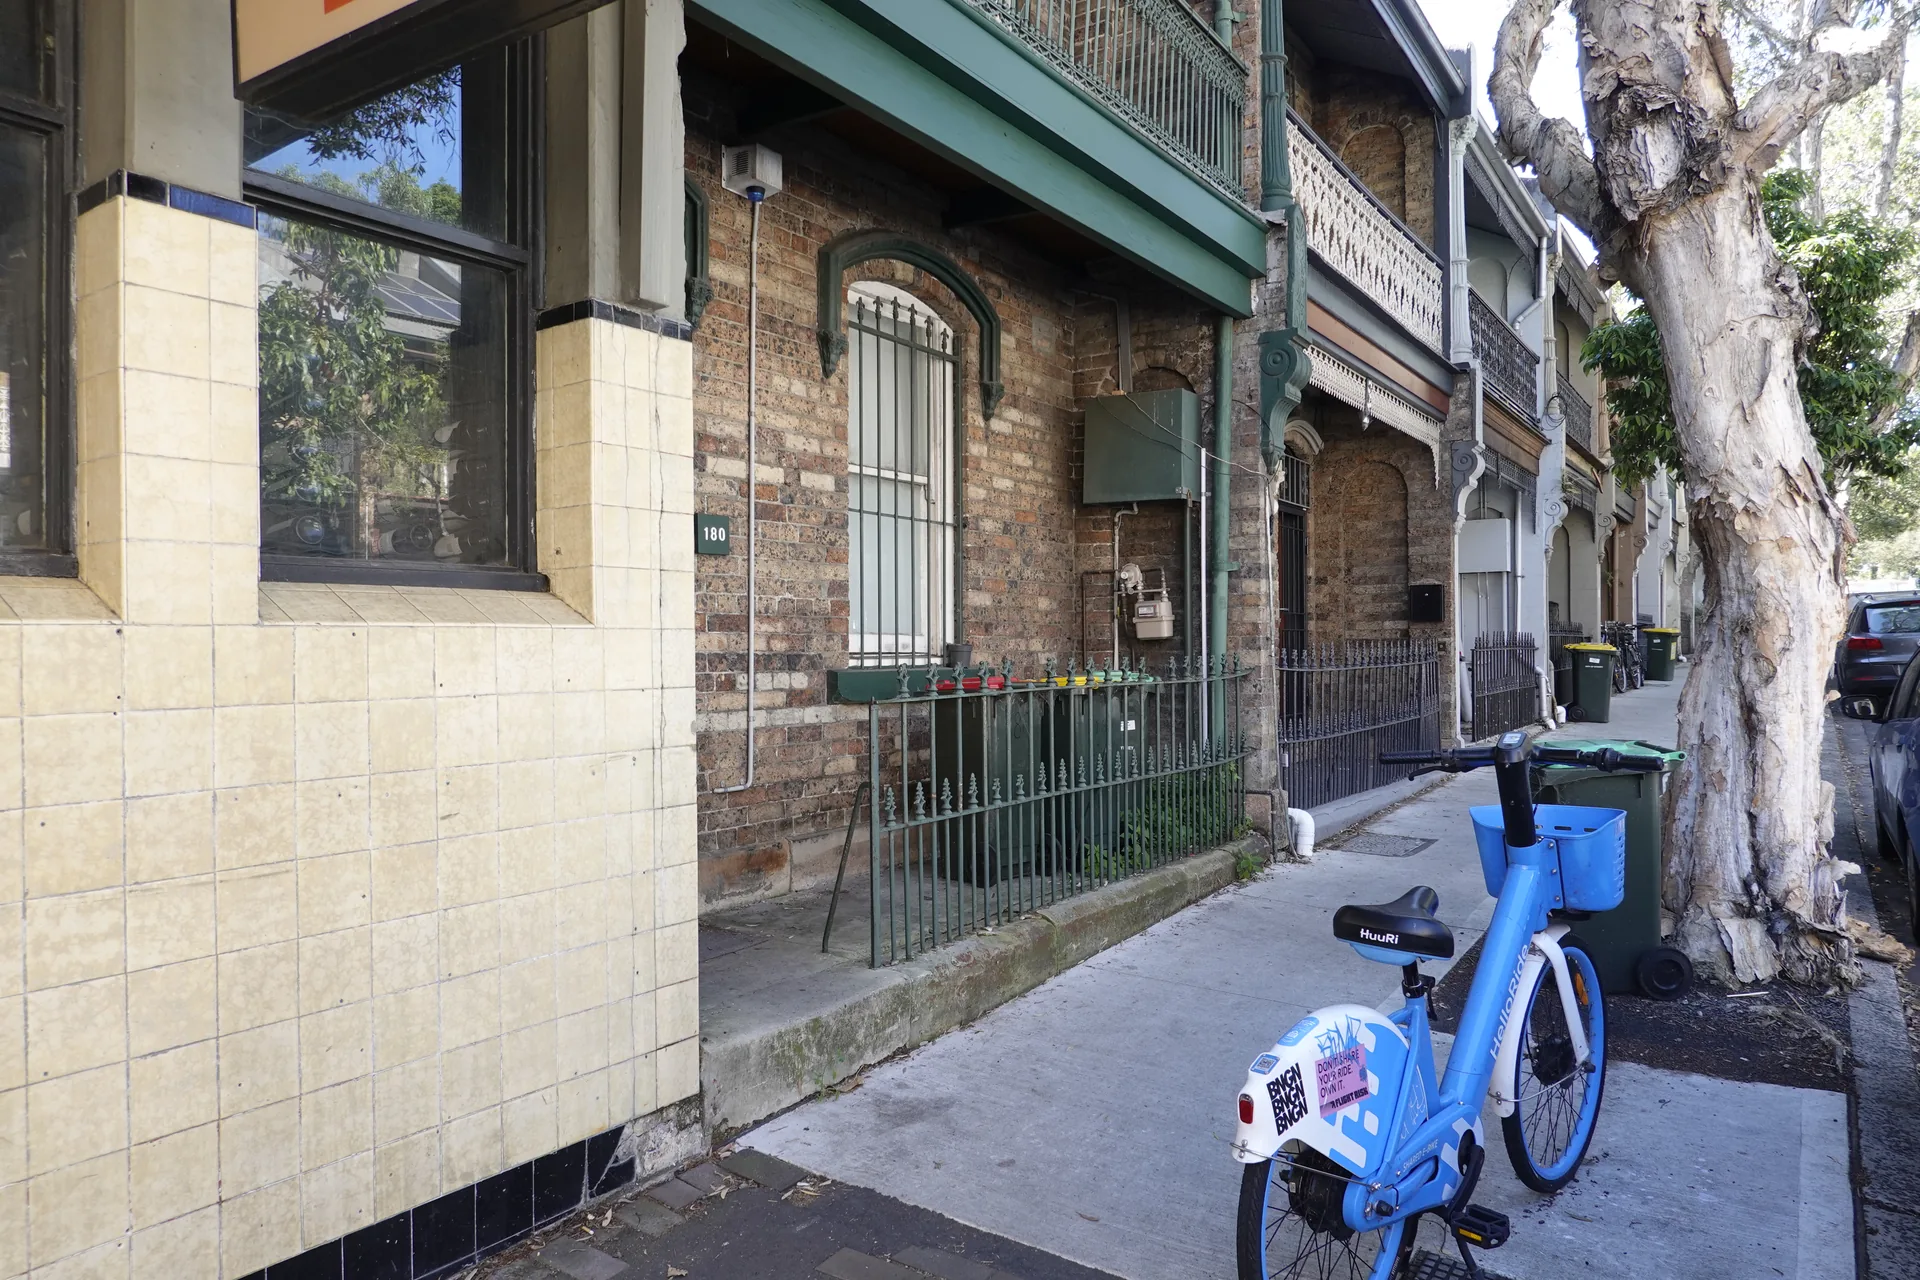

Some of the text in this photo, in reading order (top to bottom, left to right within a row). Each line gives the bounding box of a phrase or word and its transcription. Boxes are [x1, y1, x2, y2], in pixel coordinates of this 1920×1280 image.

[704, 527, 726, 541] 180
[1360, 928, 1399, 944] HuuRi
[1490, 944, 1529, 1060] HelloRide
[1266, 1062, 1302, 1100] BNGN
[1319, 1064, 1353, 1085] YOUR RIDE.
[1320, 1080, 1346, 1098] OWN IT.
[1271, 1080, 1305, 1119] BNGN
[1275, 1098, 1308, 1136] BNGN
